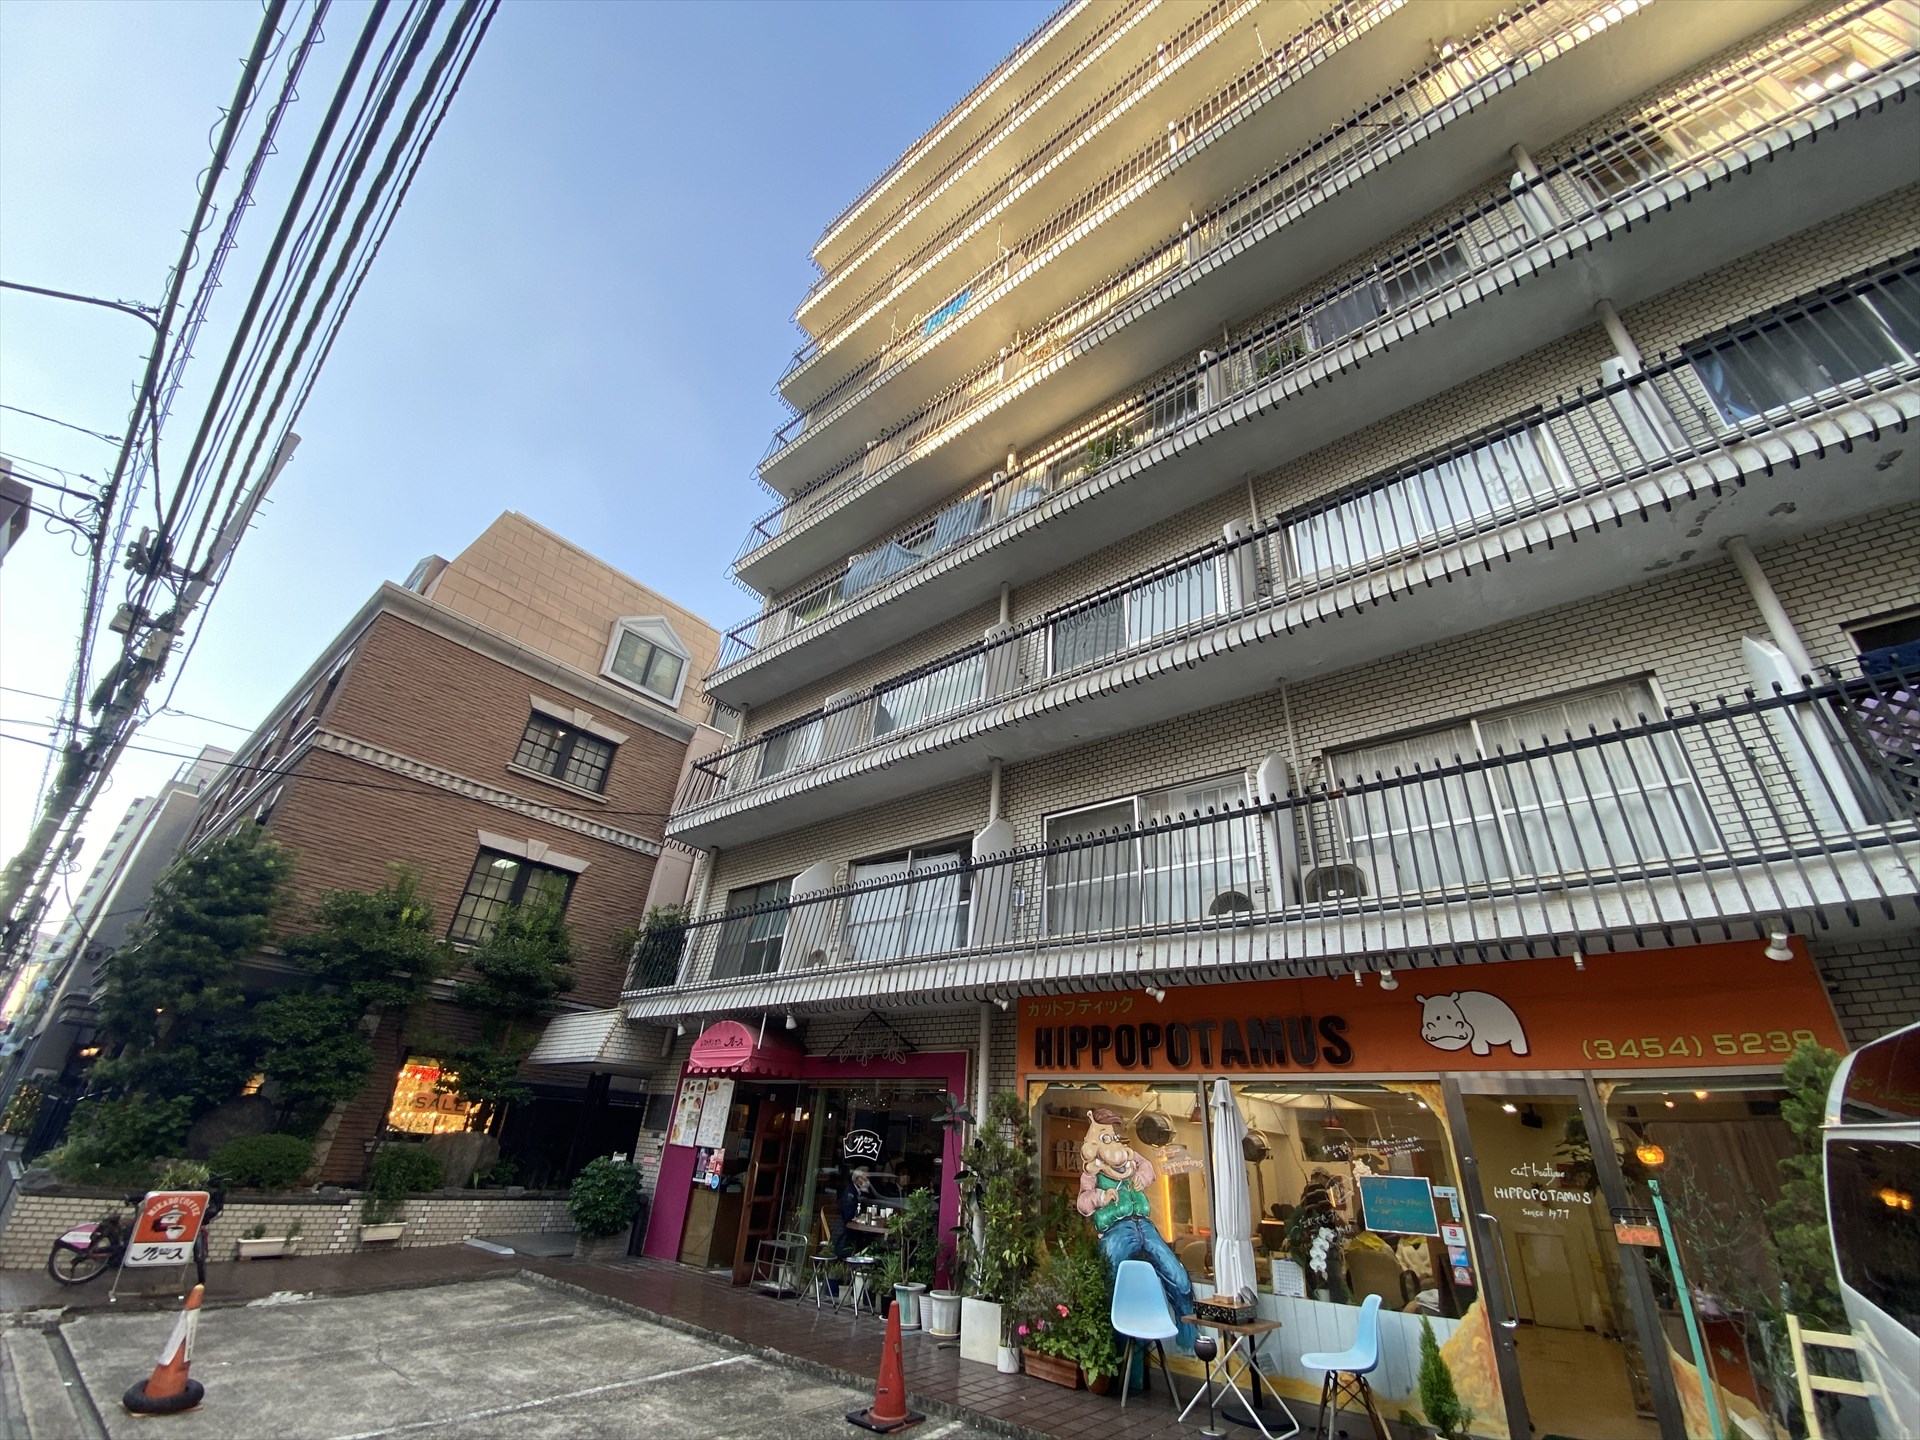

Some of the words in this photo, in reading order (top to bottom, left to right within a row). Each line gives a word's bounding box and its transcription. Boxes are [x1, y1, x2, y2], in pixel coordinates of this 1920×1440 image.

[1034, 1014, 1354, 1068] HIPPOPOTAMUS
[1582, 1035, 1703, 1060] (3454)
[407, 1066, 440, 1082] OPEN
[415, 1096, 465, 1113] SALE
[1510, 1162, 1531, 1177] cut
[1493, 1186, 1592, 1205] HIPPOPOTAMUS
[1548, 1208, 1570, 1220] 1977
